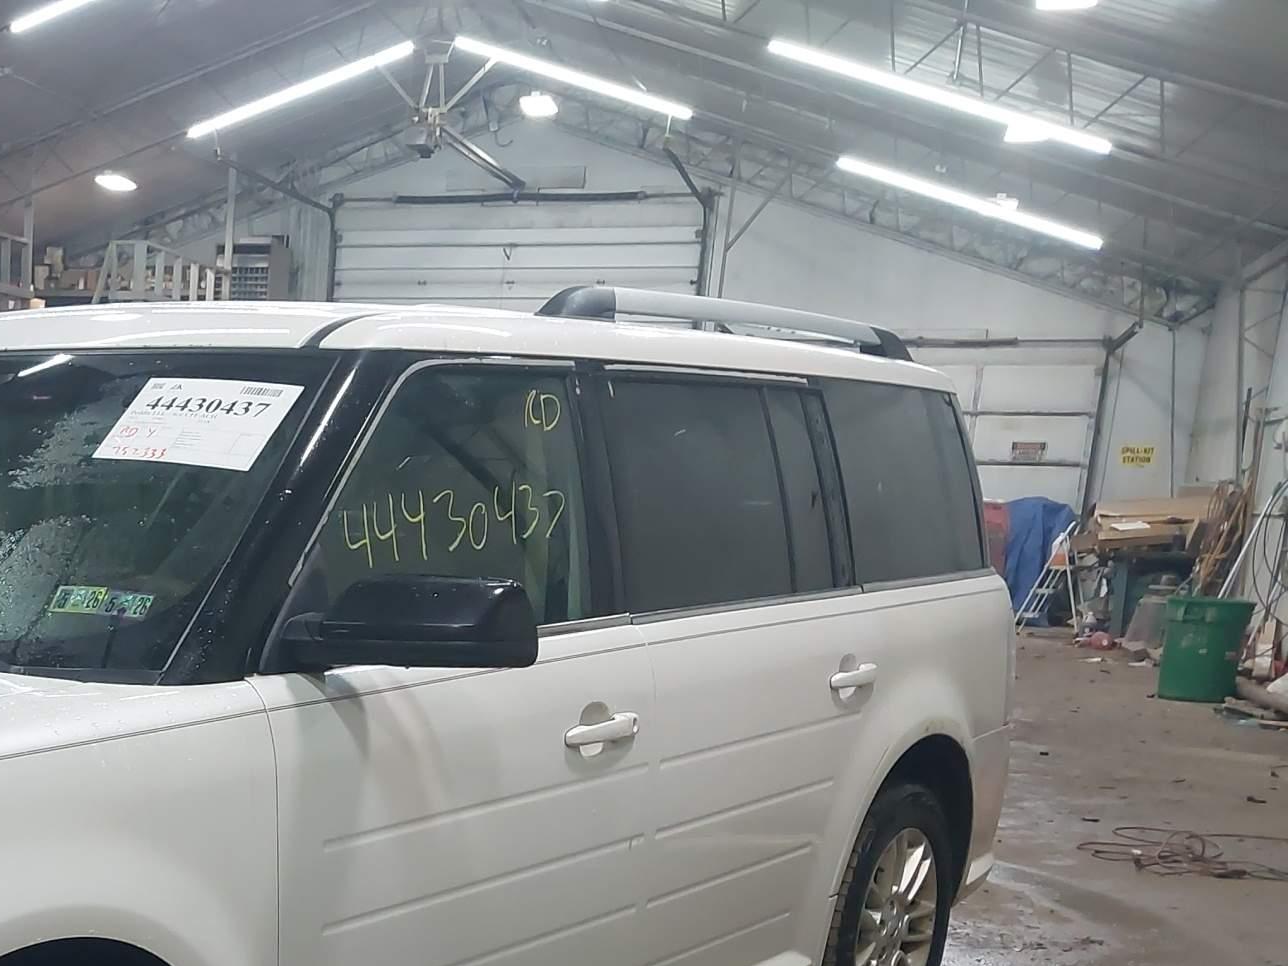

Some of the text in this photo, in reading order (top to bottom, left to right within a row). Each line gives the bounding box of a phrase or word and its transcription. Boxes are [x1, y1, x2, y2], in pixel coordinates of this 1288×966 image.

[146, 395, 272, 419] 44430437
[343, 480, 565, 568] 44430437
[85, 590, 103, 609] 26
